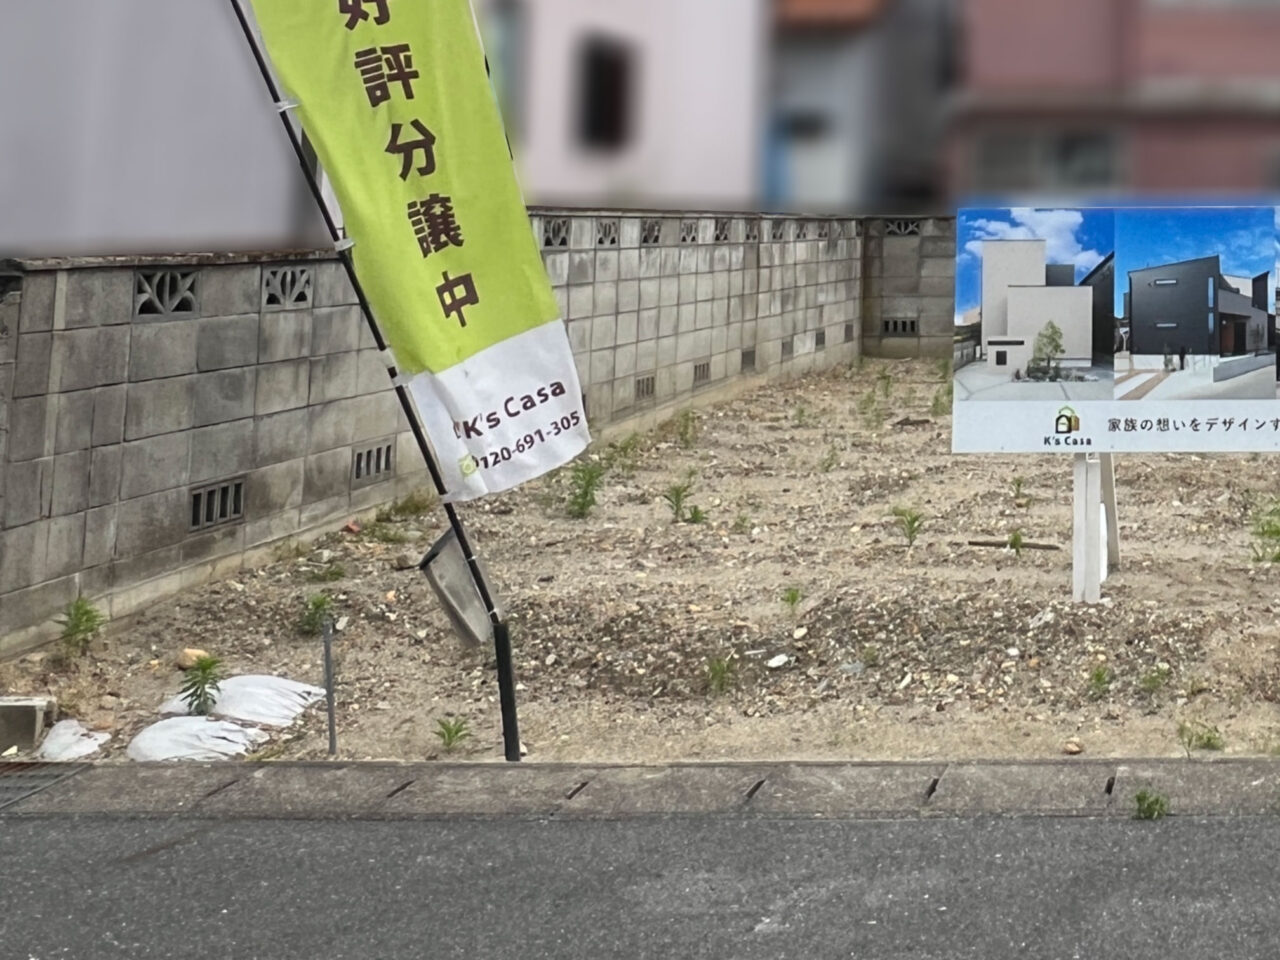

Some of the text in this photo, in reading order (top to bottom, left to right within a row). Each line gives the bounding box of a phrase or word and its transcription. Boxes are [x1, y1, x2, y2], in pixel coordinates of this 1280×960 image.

[462, 381, 567, 440] K's Casa
[1043, 435, 1092, 446] K's Casa
